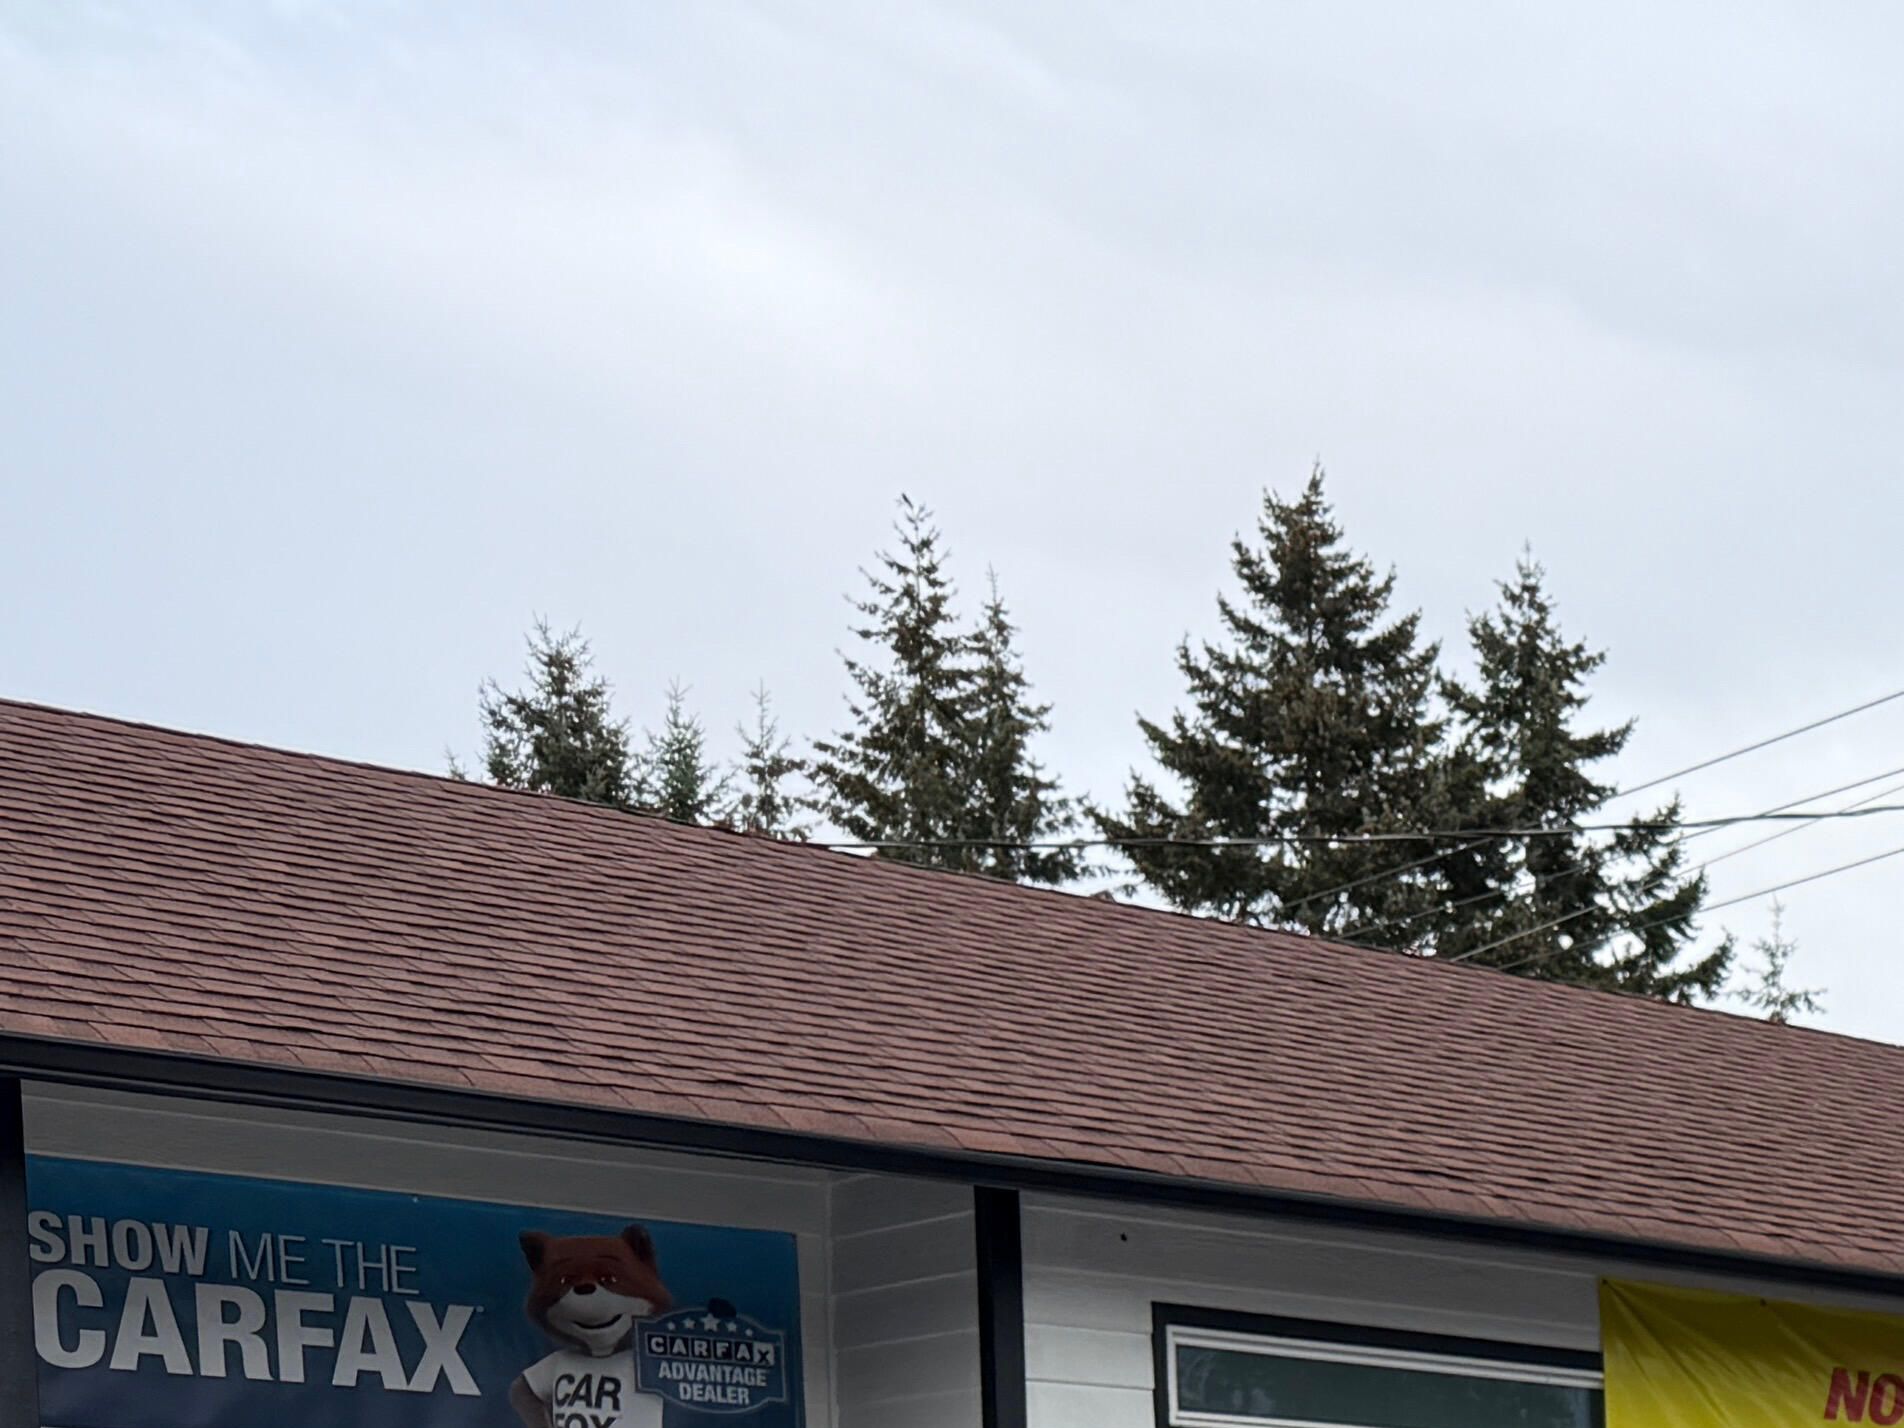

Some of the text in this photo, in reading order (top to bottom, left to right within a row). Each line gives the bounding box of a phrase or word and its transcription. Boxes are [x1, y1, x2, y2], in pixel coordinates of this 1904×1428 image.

[28, 1210, 420, 1295] SHOW ME THE
[32, 1268, 482, 1396] CARFAX
[650, 1336, 775, 1366] CARFAX
[658, 1360, 768, 1387] ADVANTAGE
[554, 1373, 622, 1412] CAR
[679, 1382, 749, 1405] DEALER
